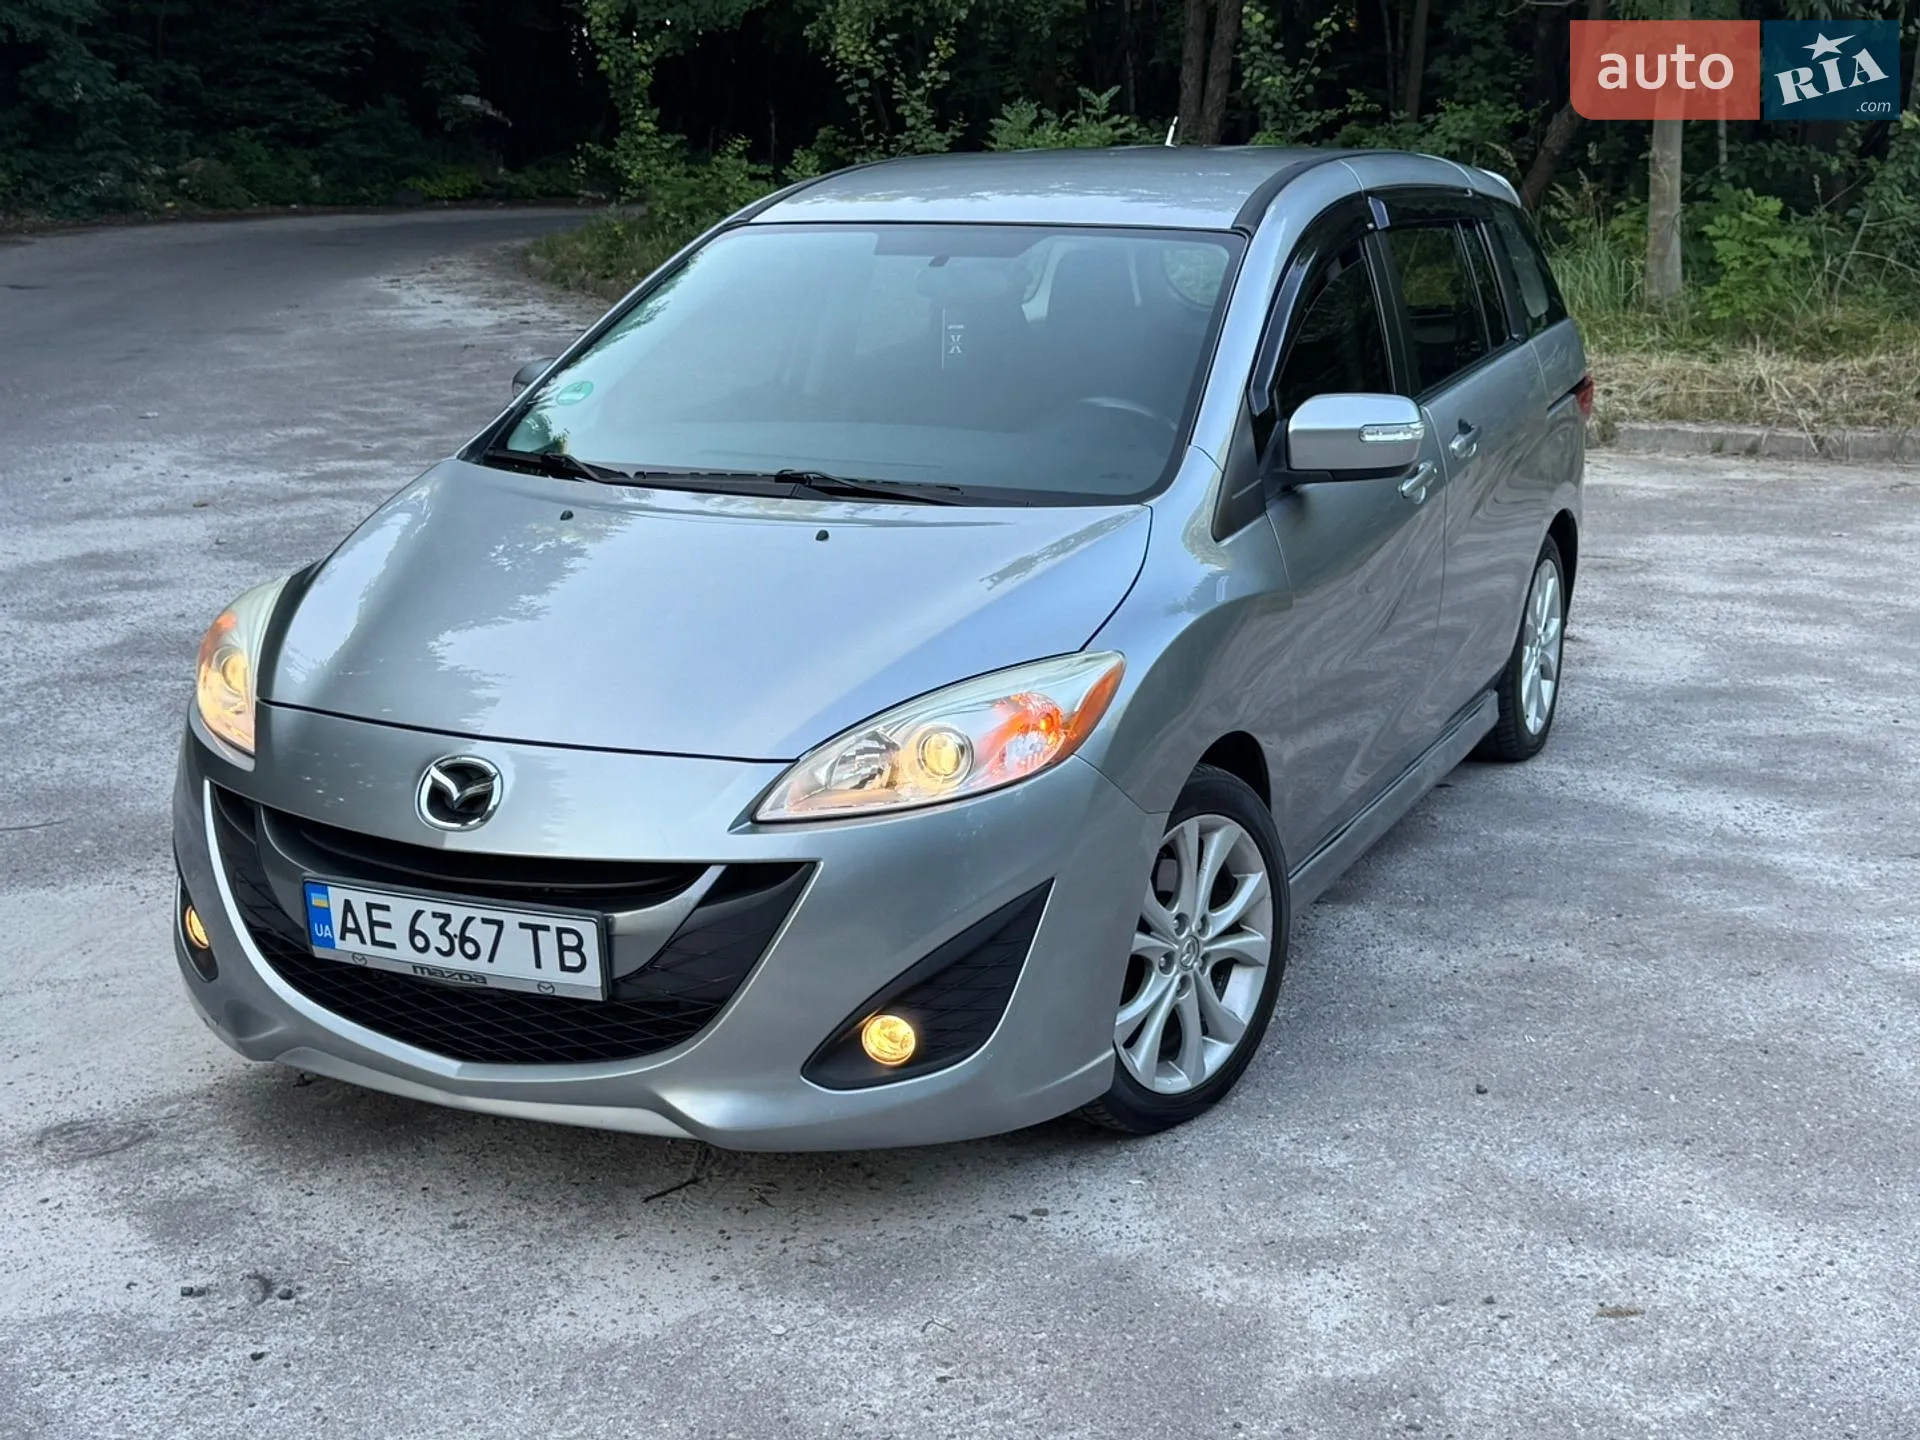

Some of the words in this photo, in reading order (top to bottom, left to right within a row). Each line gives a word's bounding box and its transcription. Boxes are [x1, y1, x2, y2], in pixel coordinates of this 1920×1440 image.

[314, 922, 333, 938] UA
[339, 898, 397, 950] AE
[408, 909, 504, 963] 6367
[518, 922, 587, 973] TB
